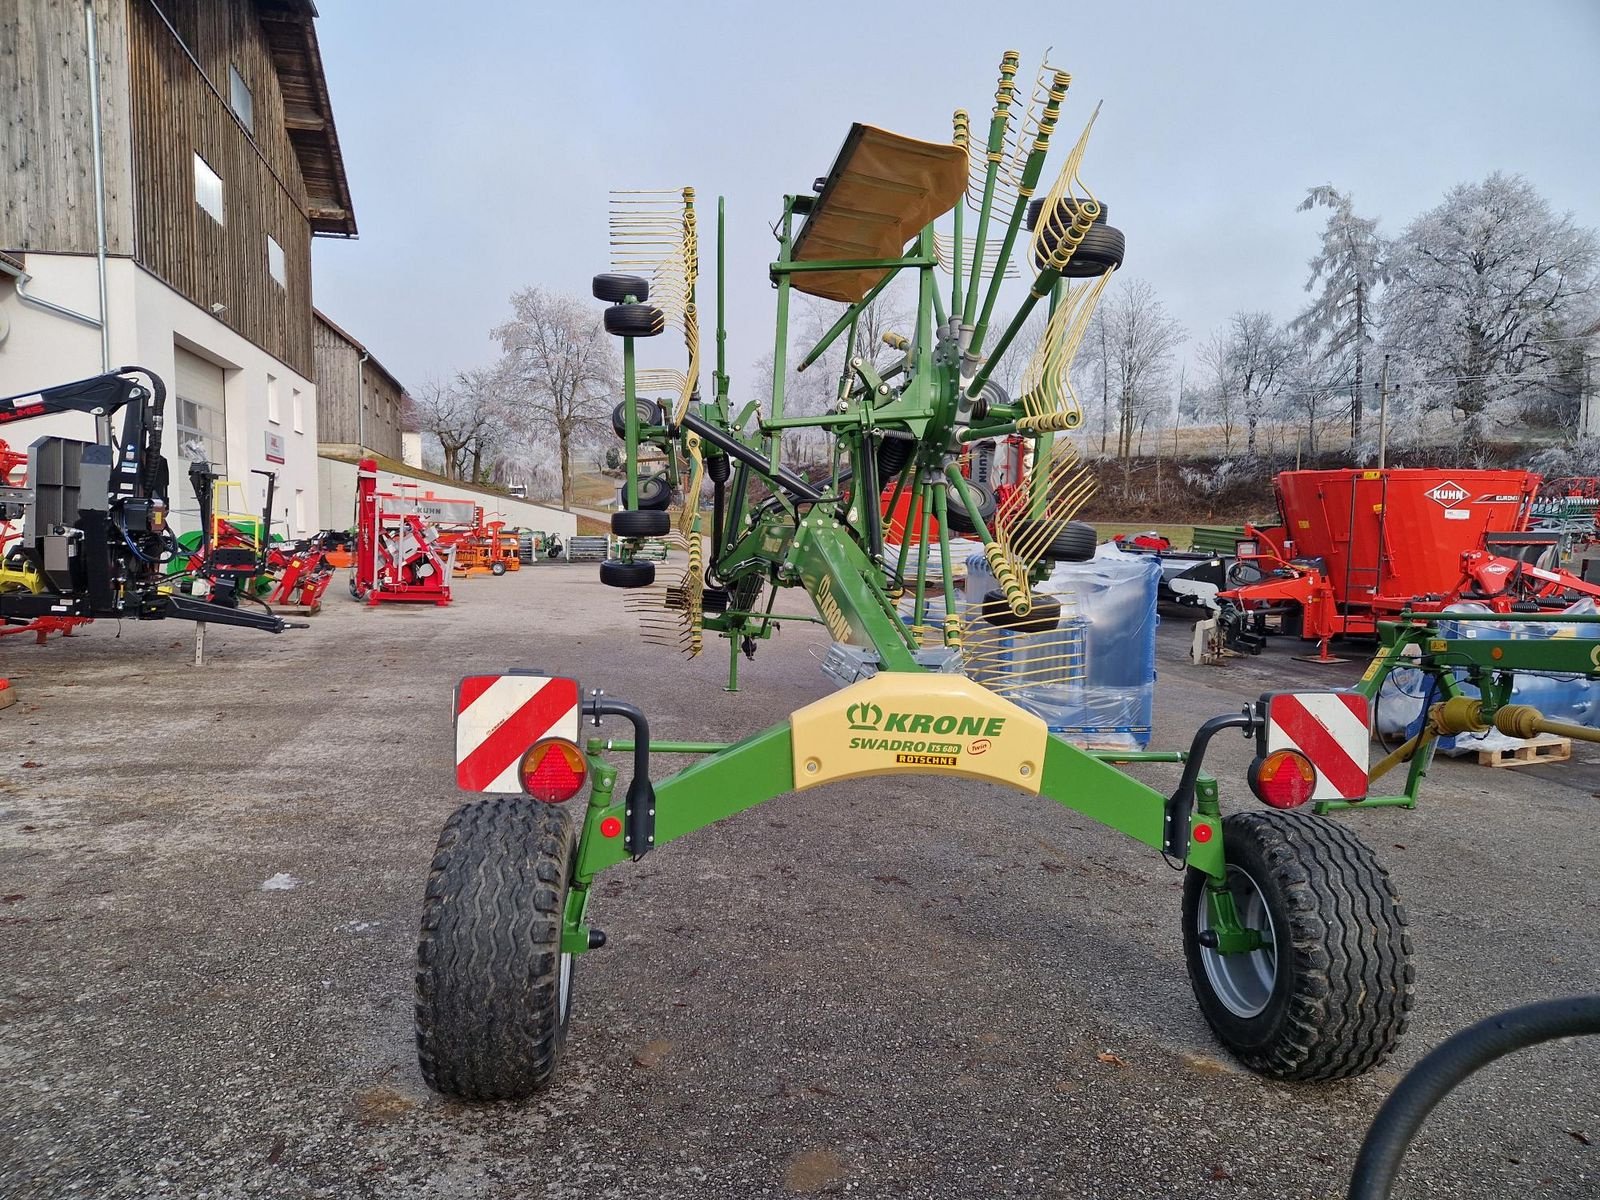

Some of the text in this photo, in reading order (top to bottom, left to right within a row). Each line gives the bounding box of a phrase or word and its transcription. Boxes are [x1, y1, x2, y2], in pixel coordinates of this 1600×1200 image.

[1433, 490, 1463, 499] KUHN
[884, 713, 1006, 736] KRONE
[849, 737, 927, 752] SWADRO
[942, 744, 958, 753] 680
[899, 755, 954, 765] ROTSCHNE
